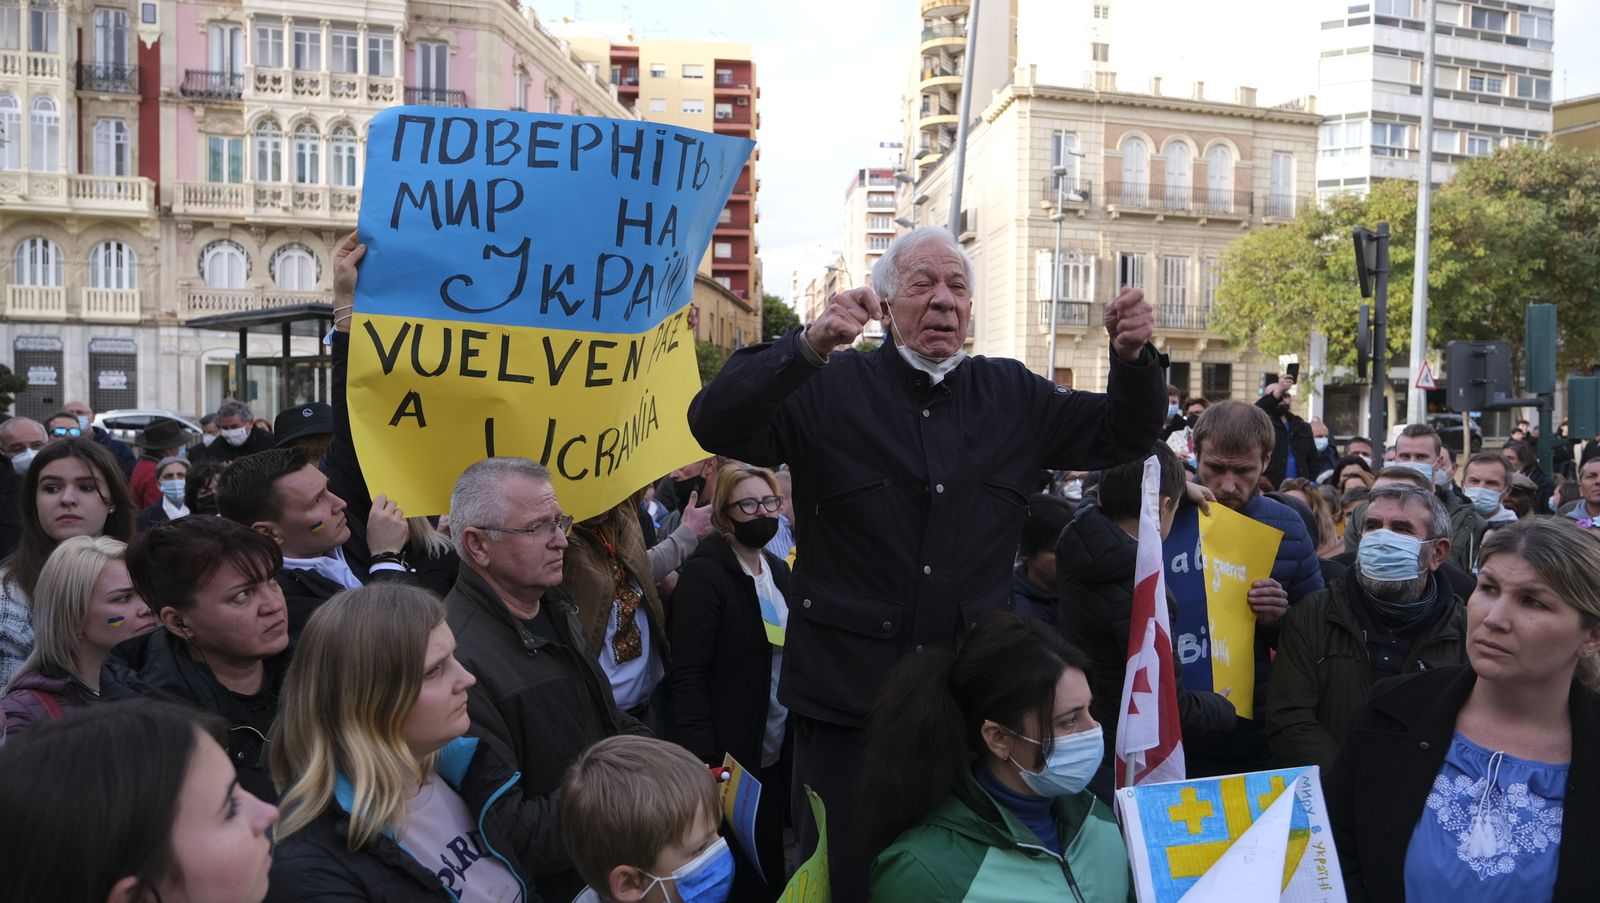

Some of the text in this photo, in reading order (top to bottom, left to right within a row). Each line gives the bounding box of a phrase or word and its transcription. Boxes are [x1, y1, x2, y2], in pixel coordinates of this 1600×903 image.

[390, 178, 677, 247] МИР НА
[363, 314, 683, 388] VUELVEN PAZ
[388, 390, 427, 428] A
